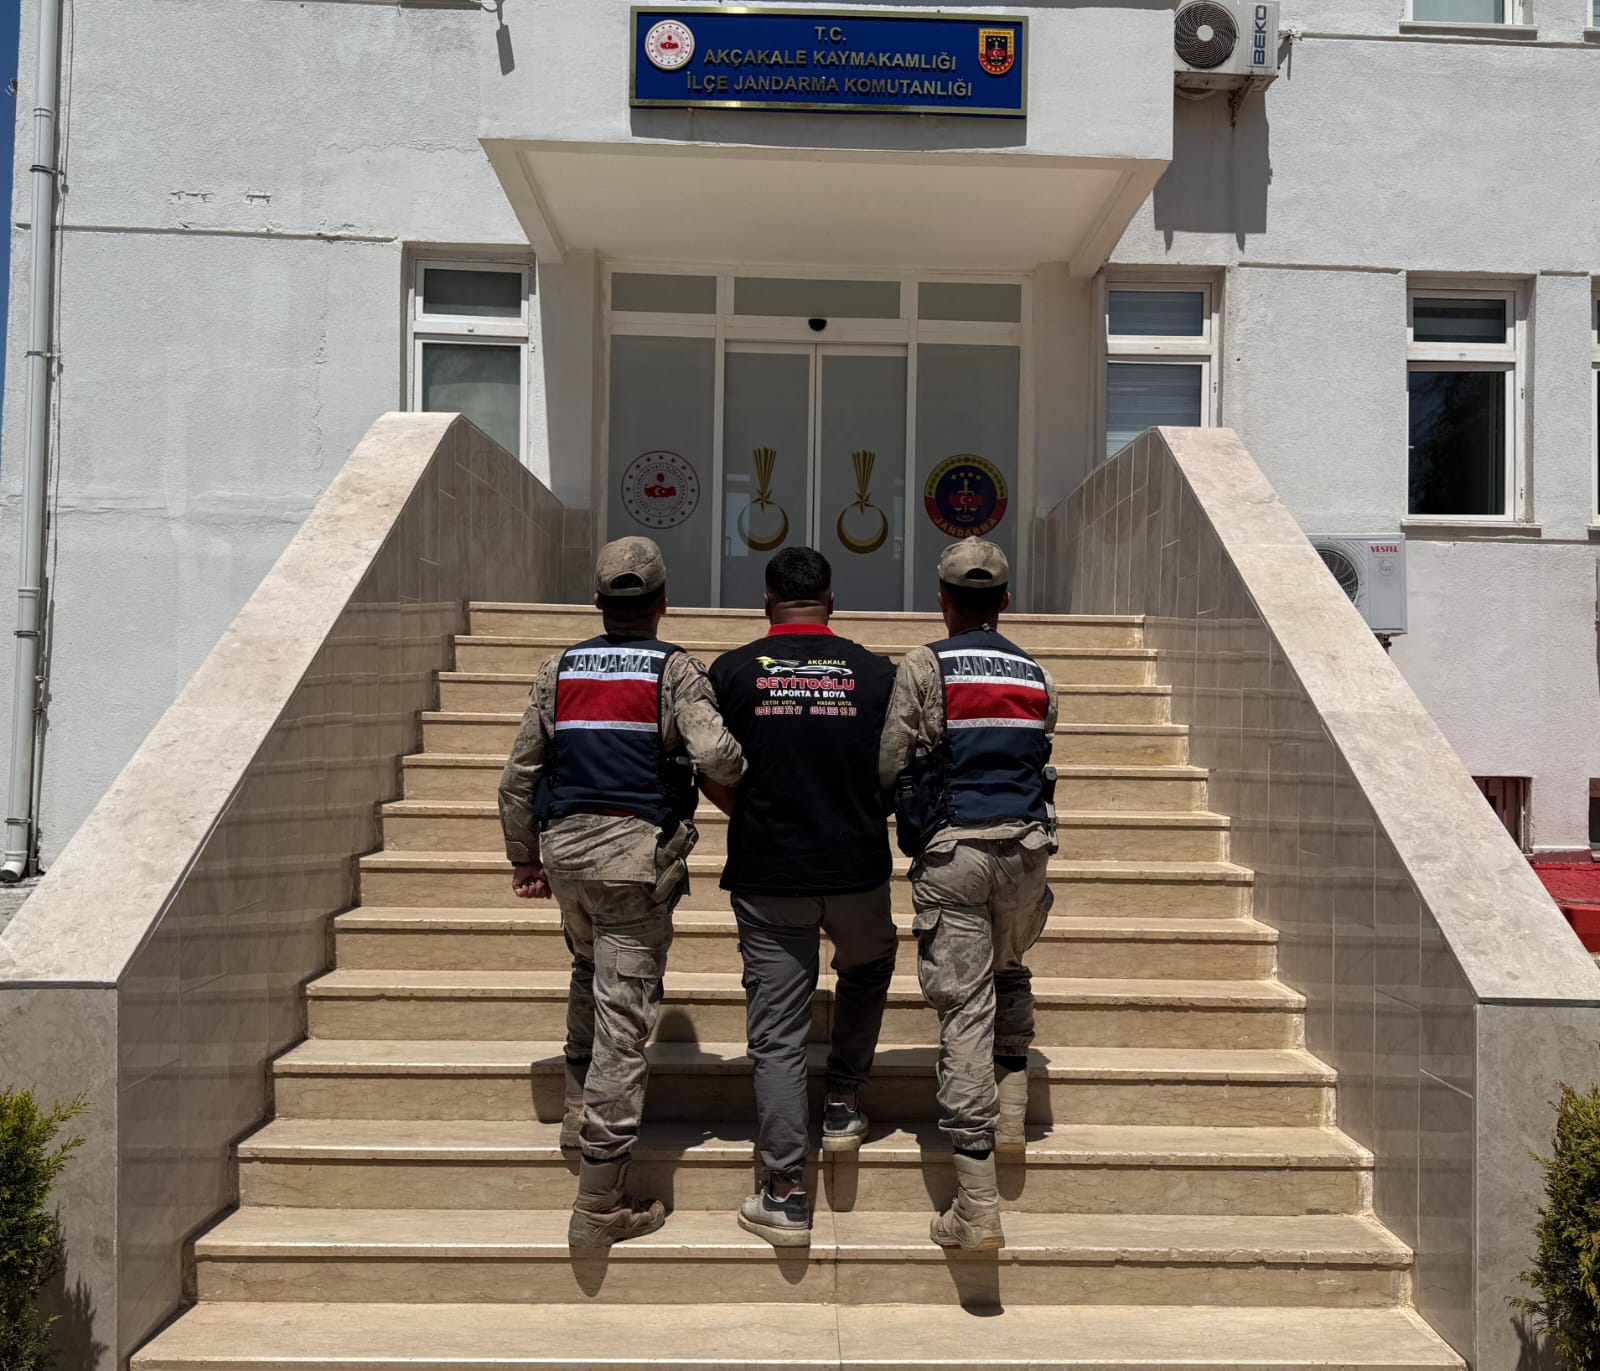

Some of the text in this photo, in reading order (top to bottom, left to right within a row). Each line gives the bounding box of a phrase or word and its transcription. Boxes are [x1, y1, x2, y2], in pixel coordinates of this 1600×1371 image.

[814, 26, 847, 43] T.C.
[1253, 5, 1267, 64] BEKO
[703, 49, 957, 71] AKÇAKALE KAYMAKAMLIĞI
[686, 71, 973, 97] İLÇE JANDARMA KOMUTANLIĞI
[568, 654, 651, 673] JANDARMA
[952, 656, 1037, 681] JANDARMA
[756, 676, 855, 690] SEYİTOĞLU
[770, 690, 811, 698] KAPORTA
